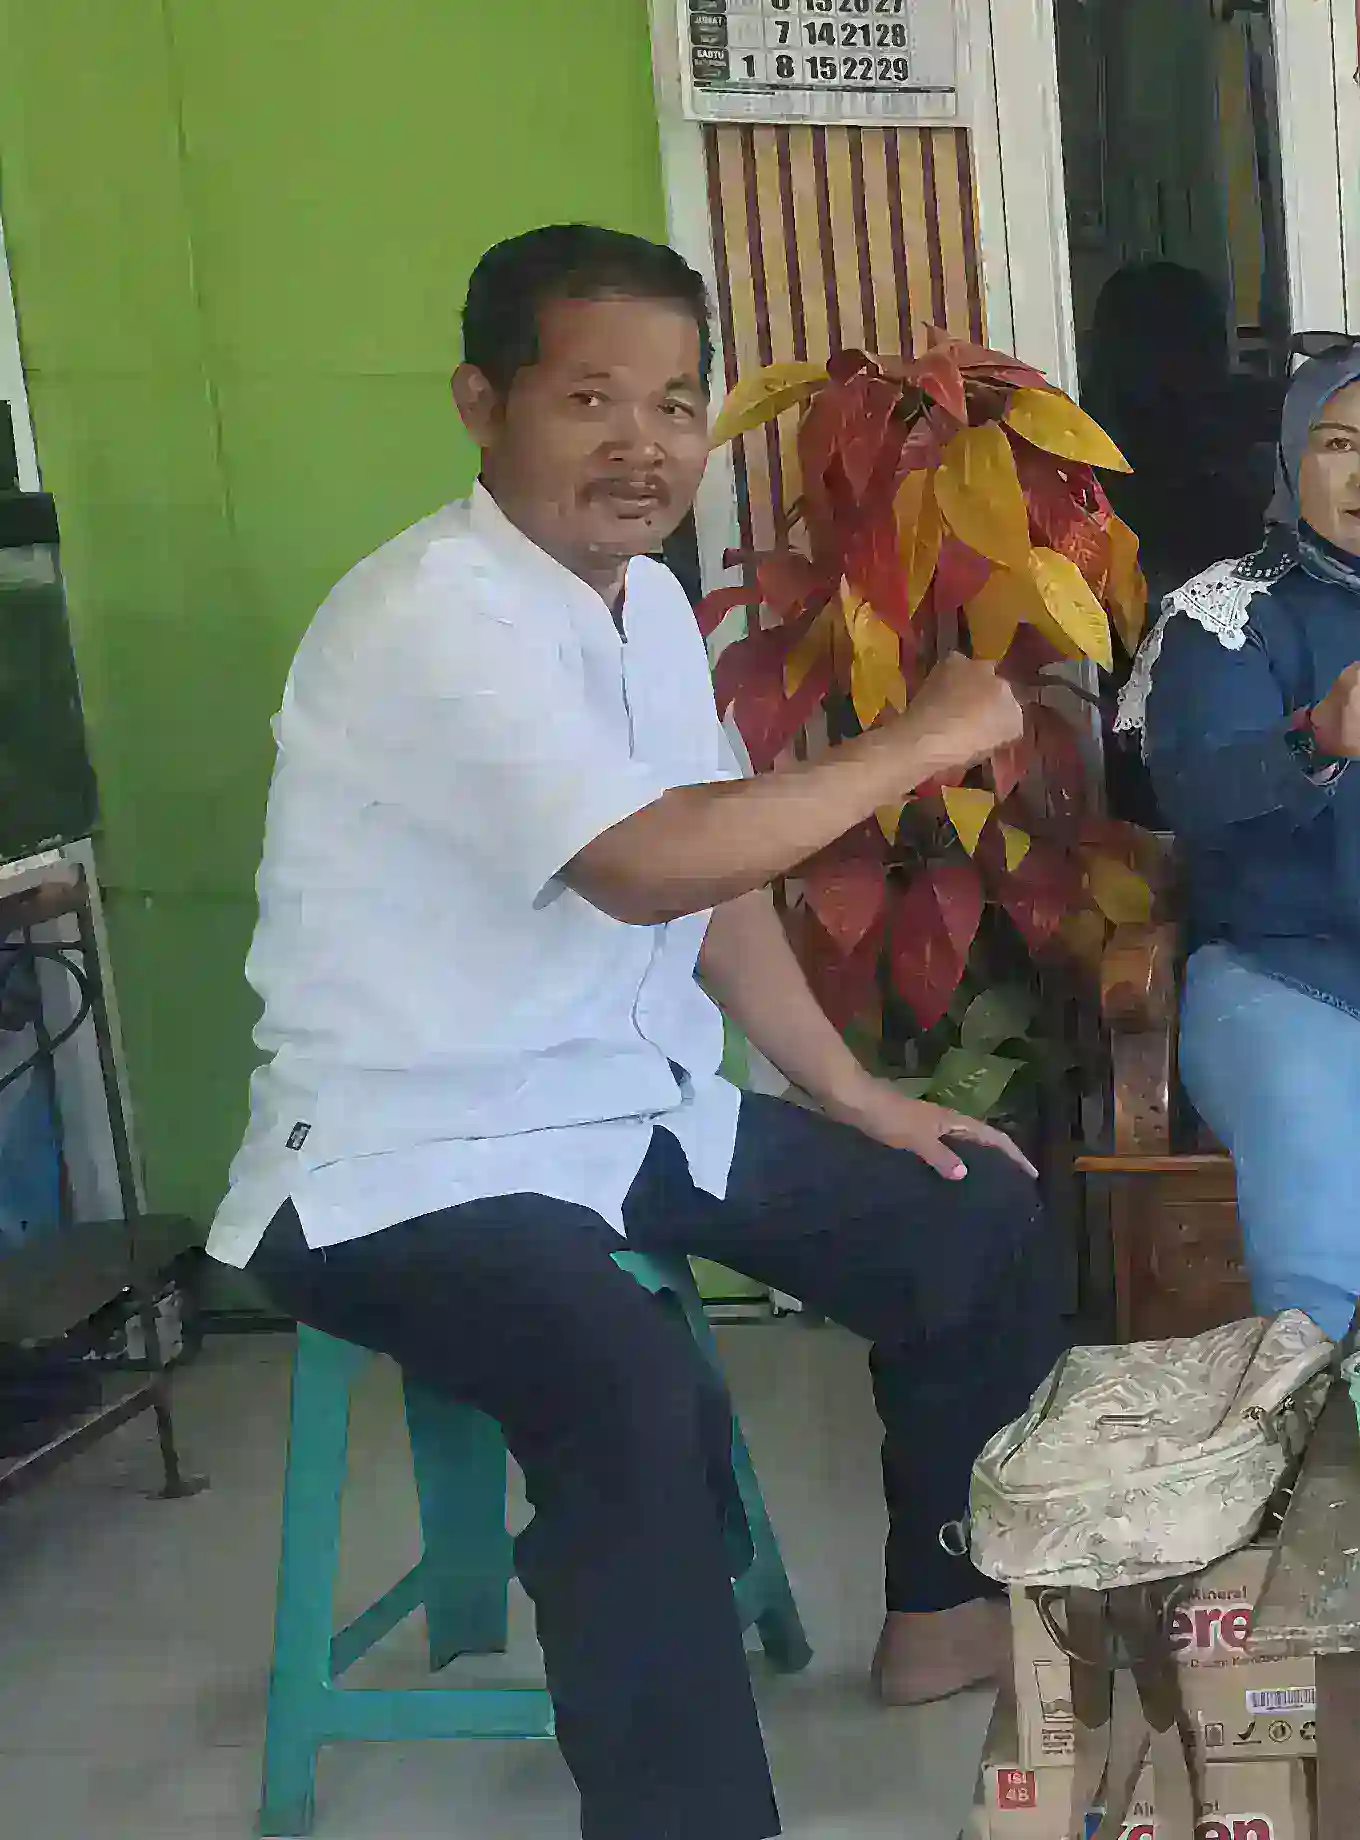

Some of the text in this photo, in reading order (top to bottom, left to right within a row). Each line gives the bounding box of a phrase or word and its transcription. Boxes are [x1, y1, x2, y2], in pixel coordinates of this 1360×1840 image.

[774, 20, 790, 44] 7
[803, 21, 836, 46] 14
[840, 22, 871, 47] 21
[875, 23, 907, 47] 28
[741, 54, 756, 78] 1
[775, 54, 795, 79] 8
[805, 56, 838, 80] 15
[842, 57, 873, 81] 22
[876, 57, 909, 82] 29
